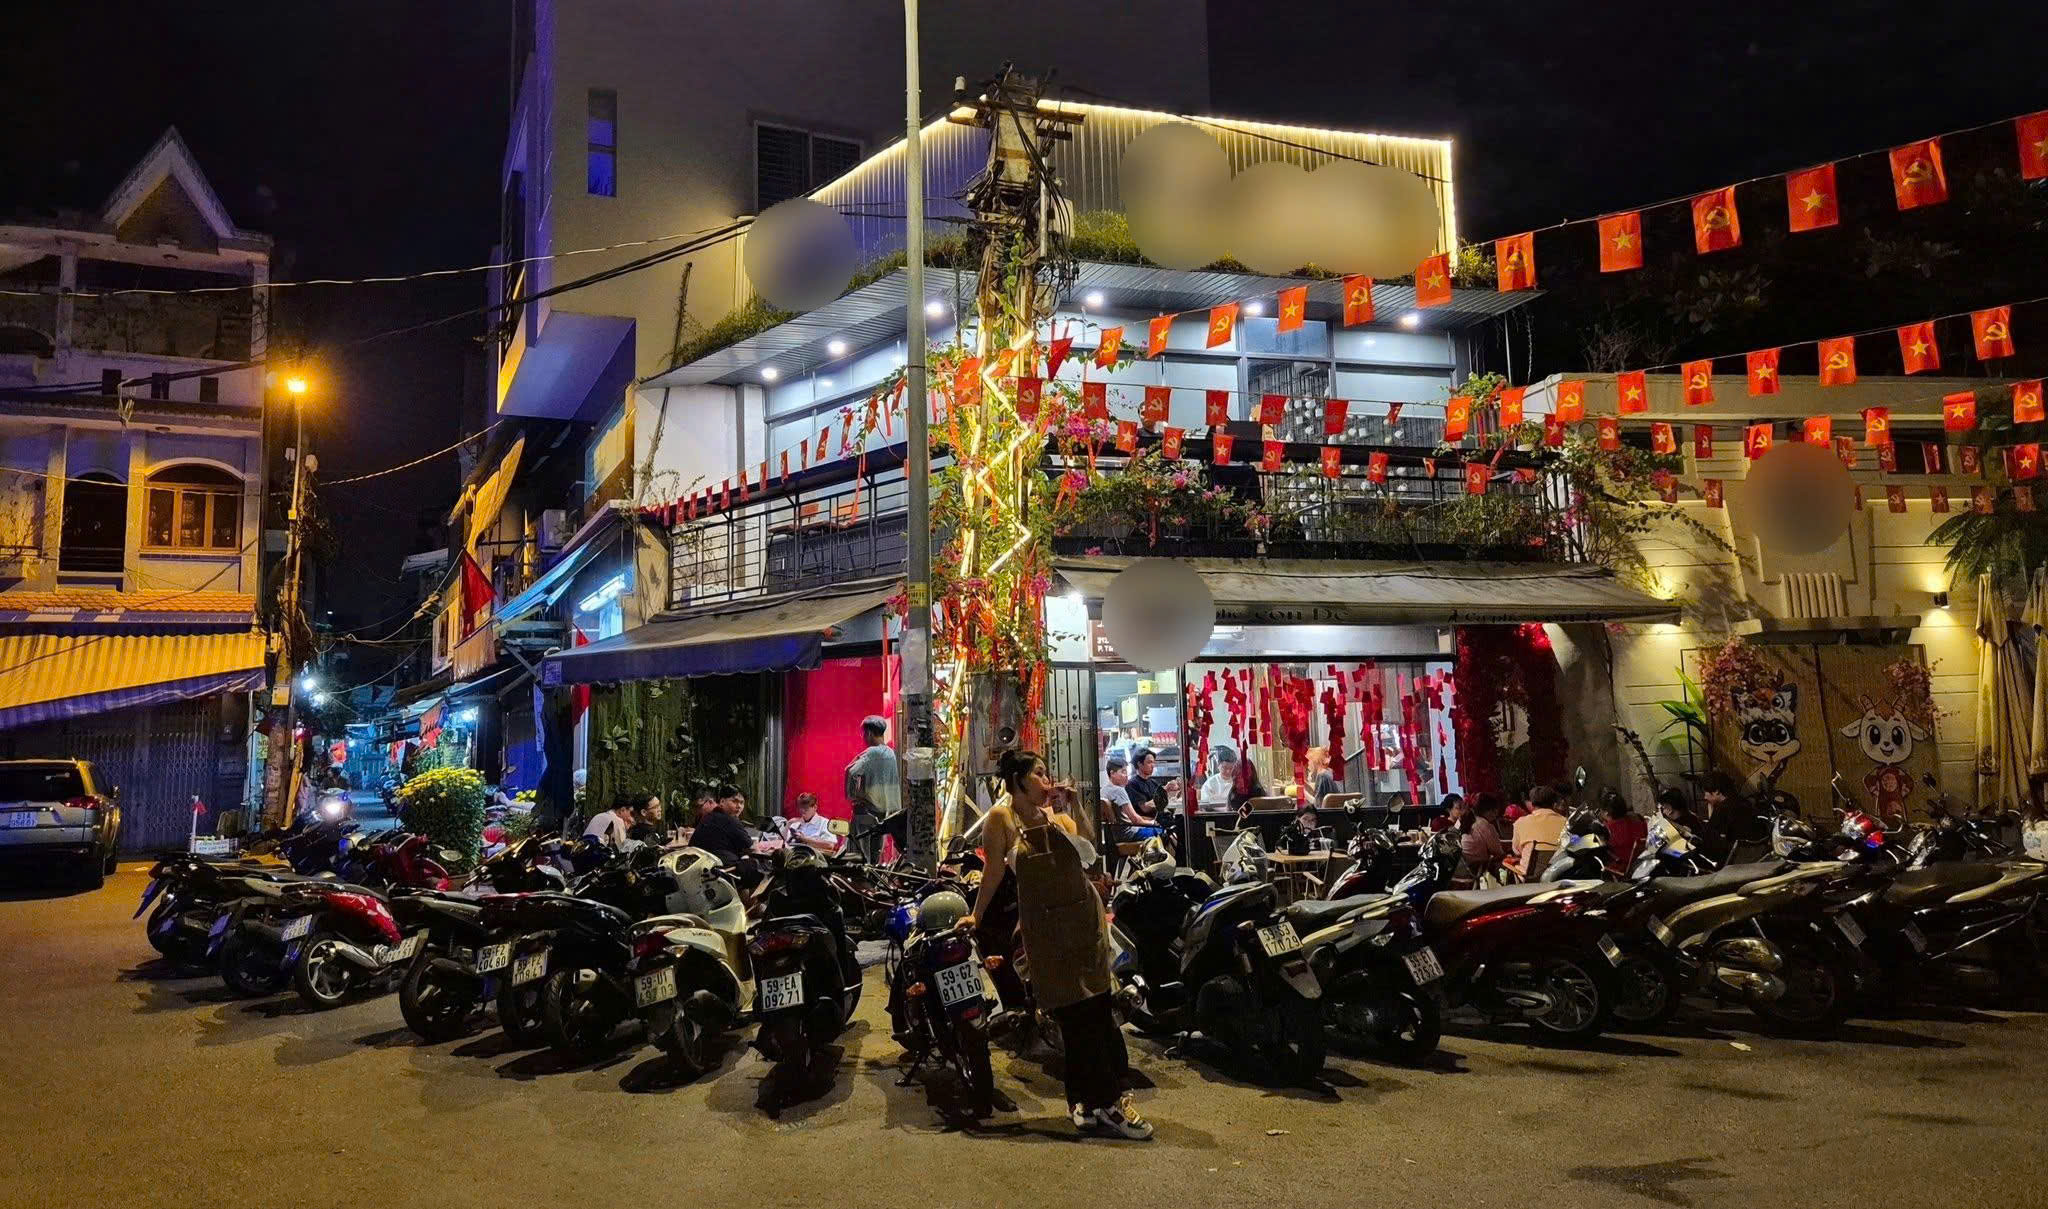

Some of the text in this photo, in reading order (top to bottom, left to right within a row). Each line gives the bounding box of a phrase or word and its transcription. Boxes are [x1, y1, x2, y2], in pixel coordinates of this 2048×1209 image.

[767, 976, 796, 993] 59-EA
[942, 978, 981, 1001] 811.60
[765, 990, 801, 1008] 092.71
